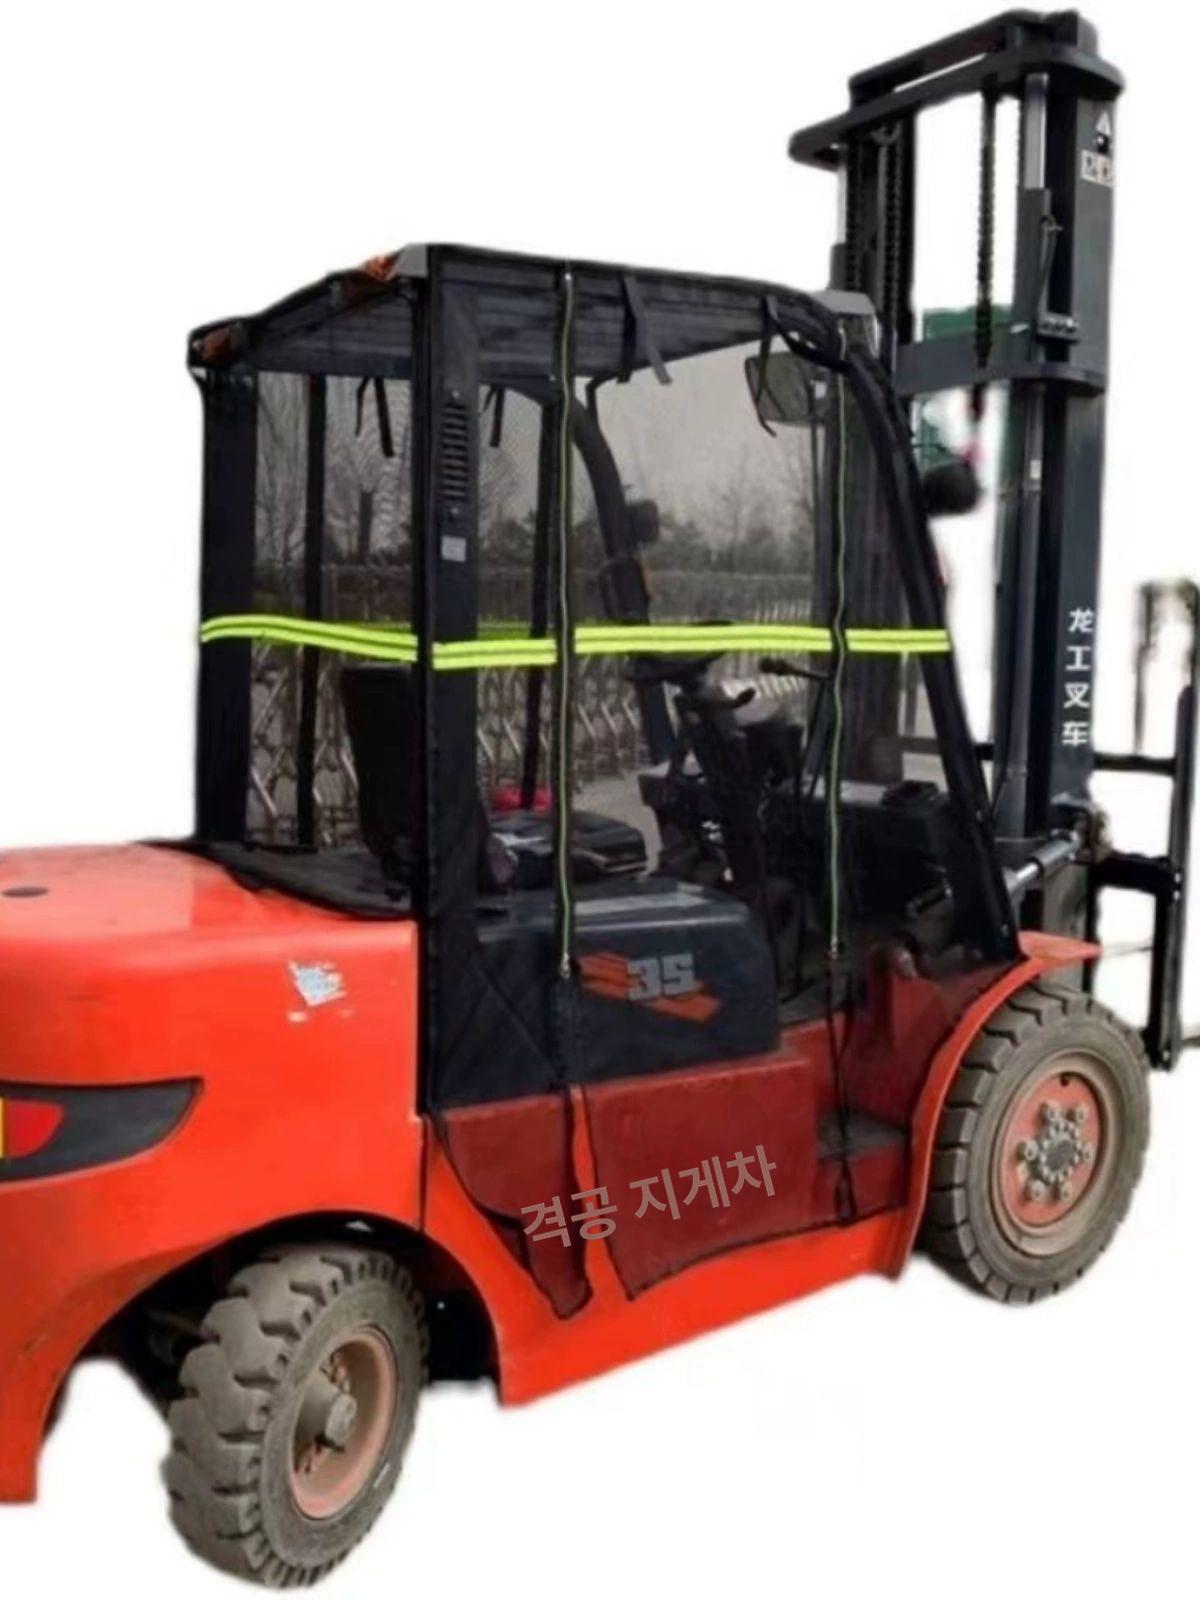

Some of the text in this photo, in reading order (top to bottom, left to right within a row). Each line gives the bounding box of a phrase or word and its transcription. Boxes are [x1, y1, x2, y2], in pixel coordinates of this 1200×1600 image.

[1061, 607, 1095, 747] 龙工叉车
[626, 953, 695, 1000] 35
